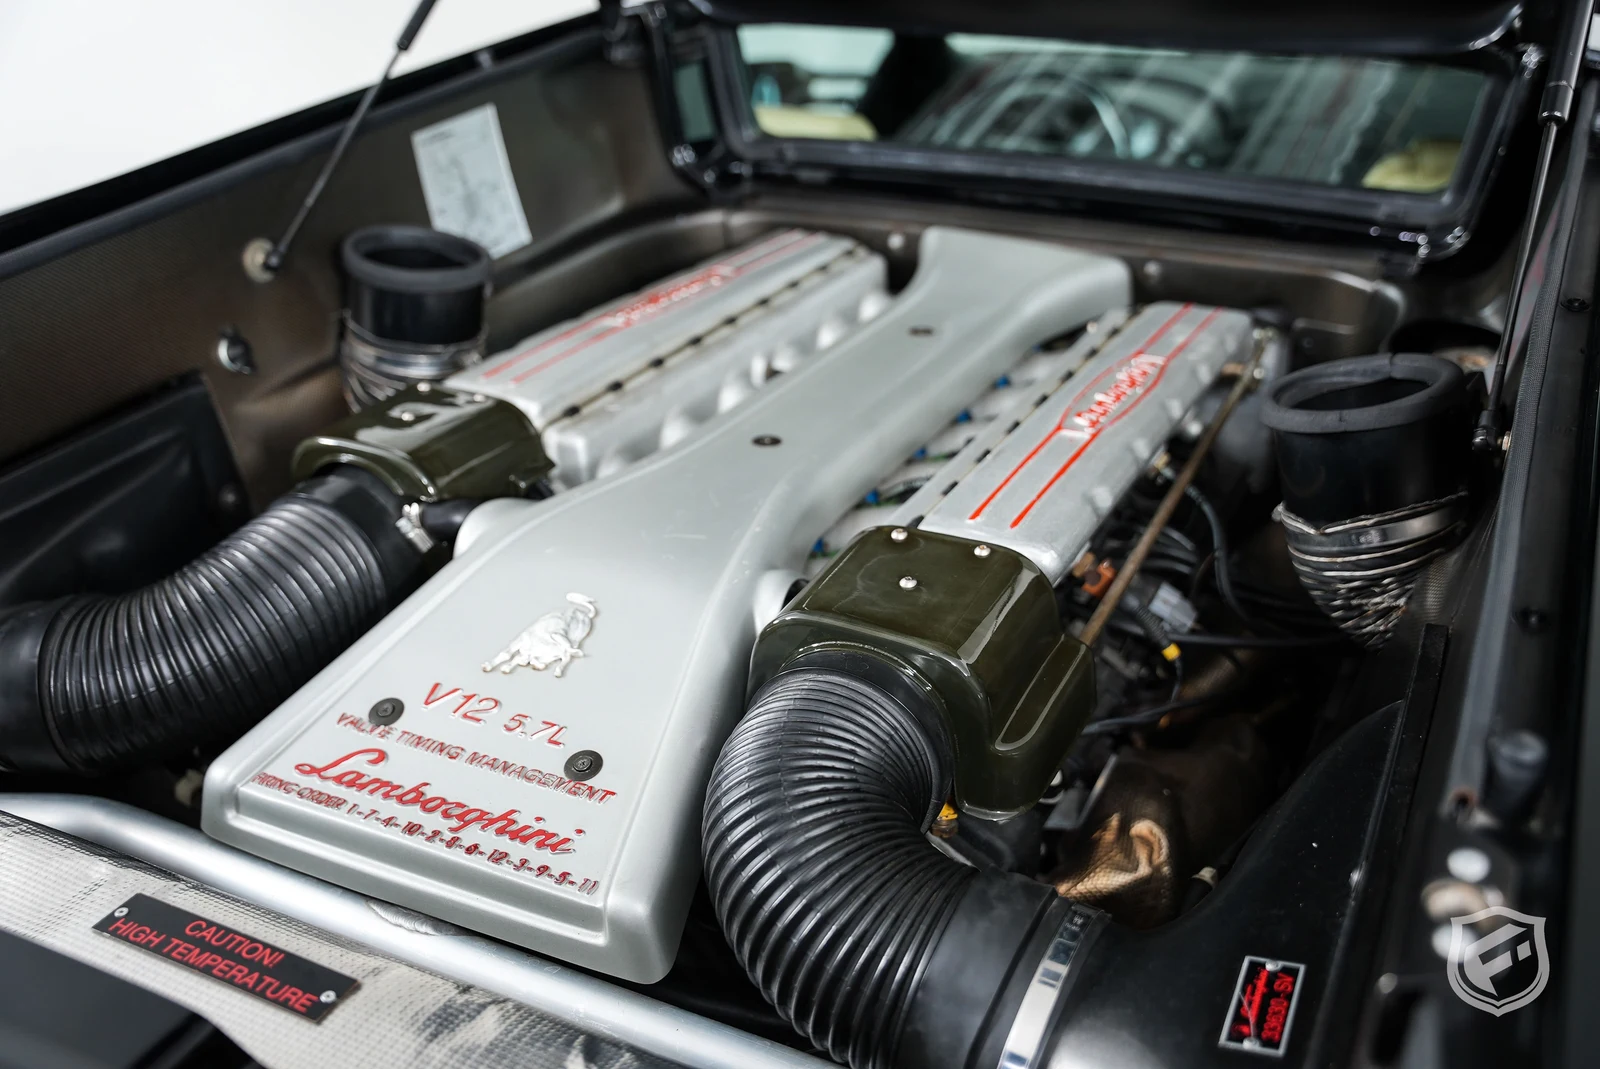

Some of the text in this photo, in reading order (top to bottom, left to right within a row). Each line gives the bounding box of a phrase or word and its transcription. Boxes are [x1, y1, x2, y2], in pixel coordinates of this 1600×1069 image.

[421, 681, 569, 749] V12 5.7L
[251, 771, 301, 795] FIRING
[296, 786, 348, 811] ORDER
[336, 712, 618, 806] VALVE TIMING MANAGEMENT
[294, 747, 587, 856] Lamborghini
[107, 917, 320, 1014] HIGH TEMPERATURE
[183, 918, 286, 969] CAUTION!
